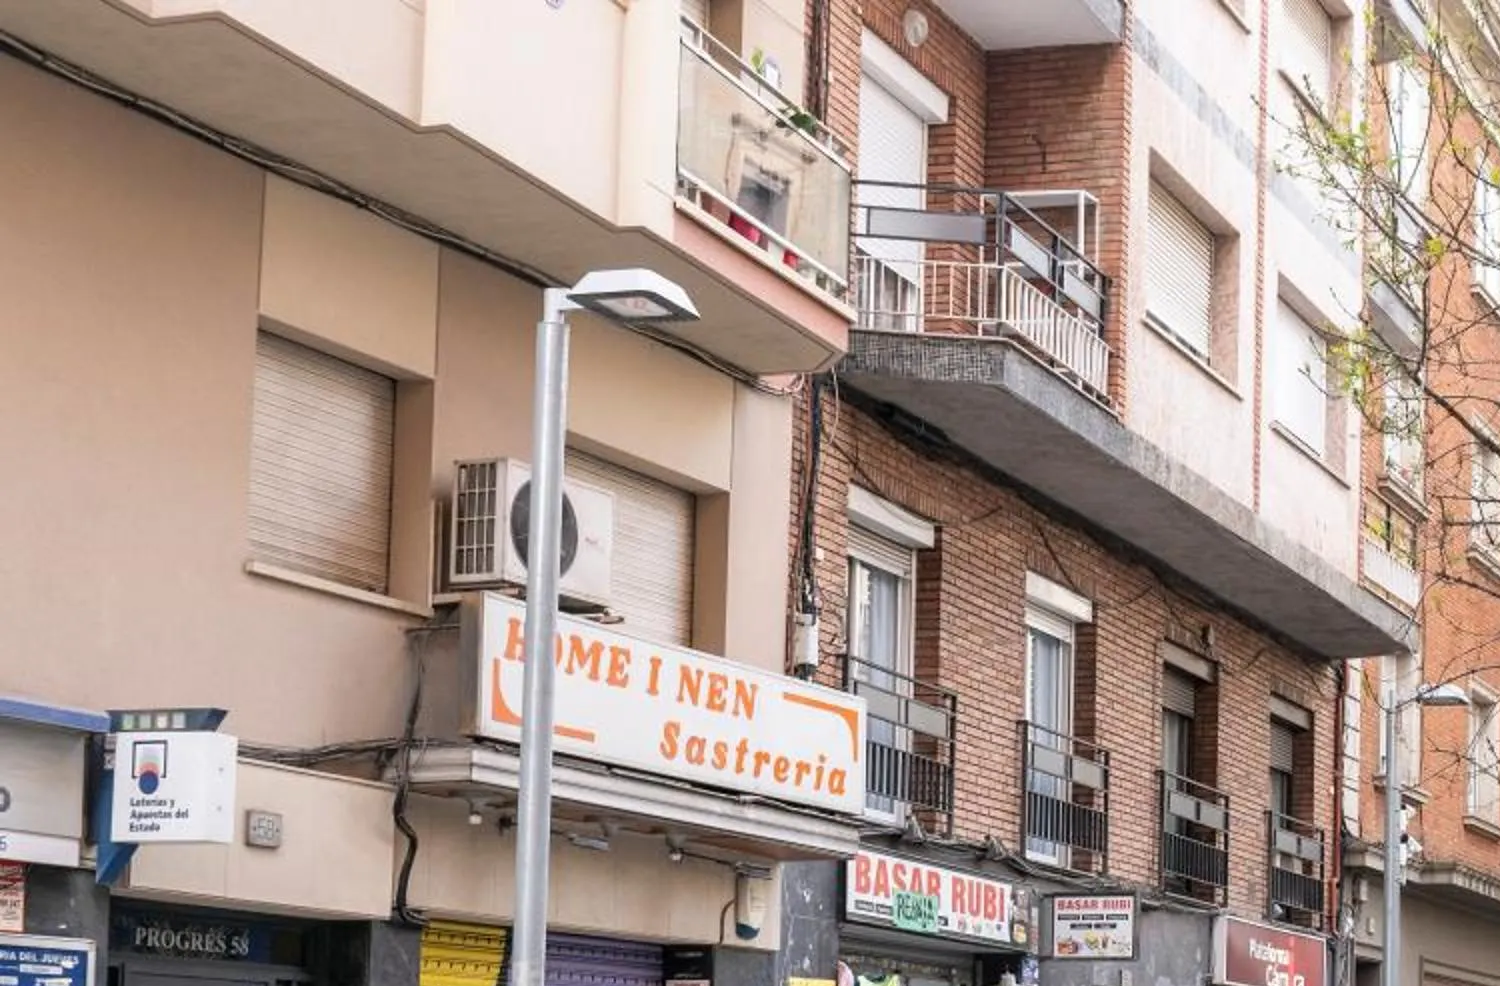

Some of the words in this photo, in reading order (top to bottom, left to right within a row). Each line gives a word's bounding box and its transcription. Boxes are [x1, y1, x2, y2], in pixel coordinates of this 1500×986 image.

[504, 617, 631, 688] HME
[646, 655, 662, 696] I
[676, 663, 759, 721] NEN
[659, 720, 847, 797] Sastreria
[175, 807, 189, 819] del
[855, 855, 941, 907] BASAR
[951, 874, 1005, 922] RUBI
